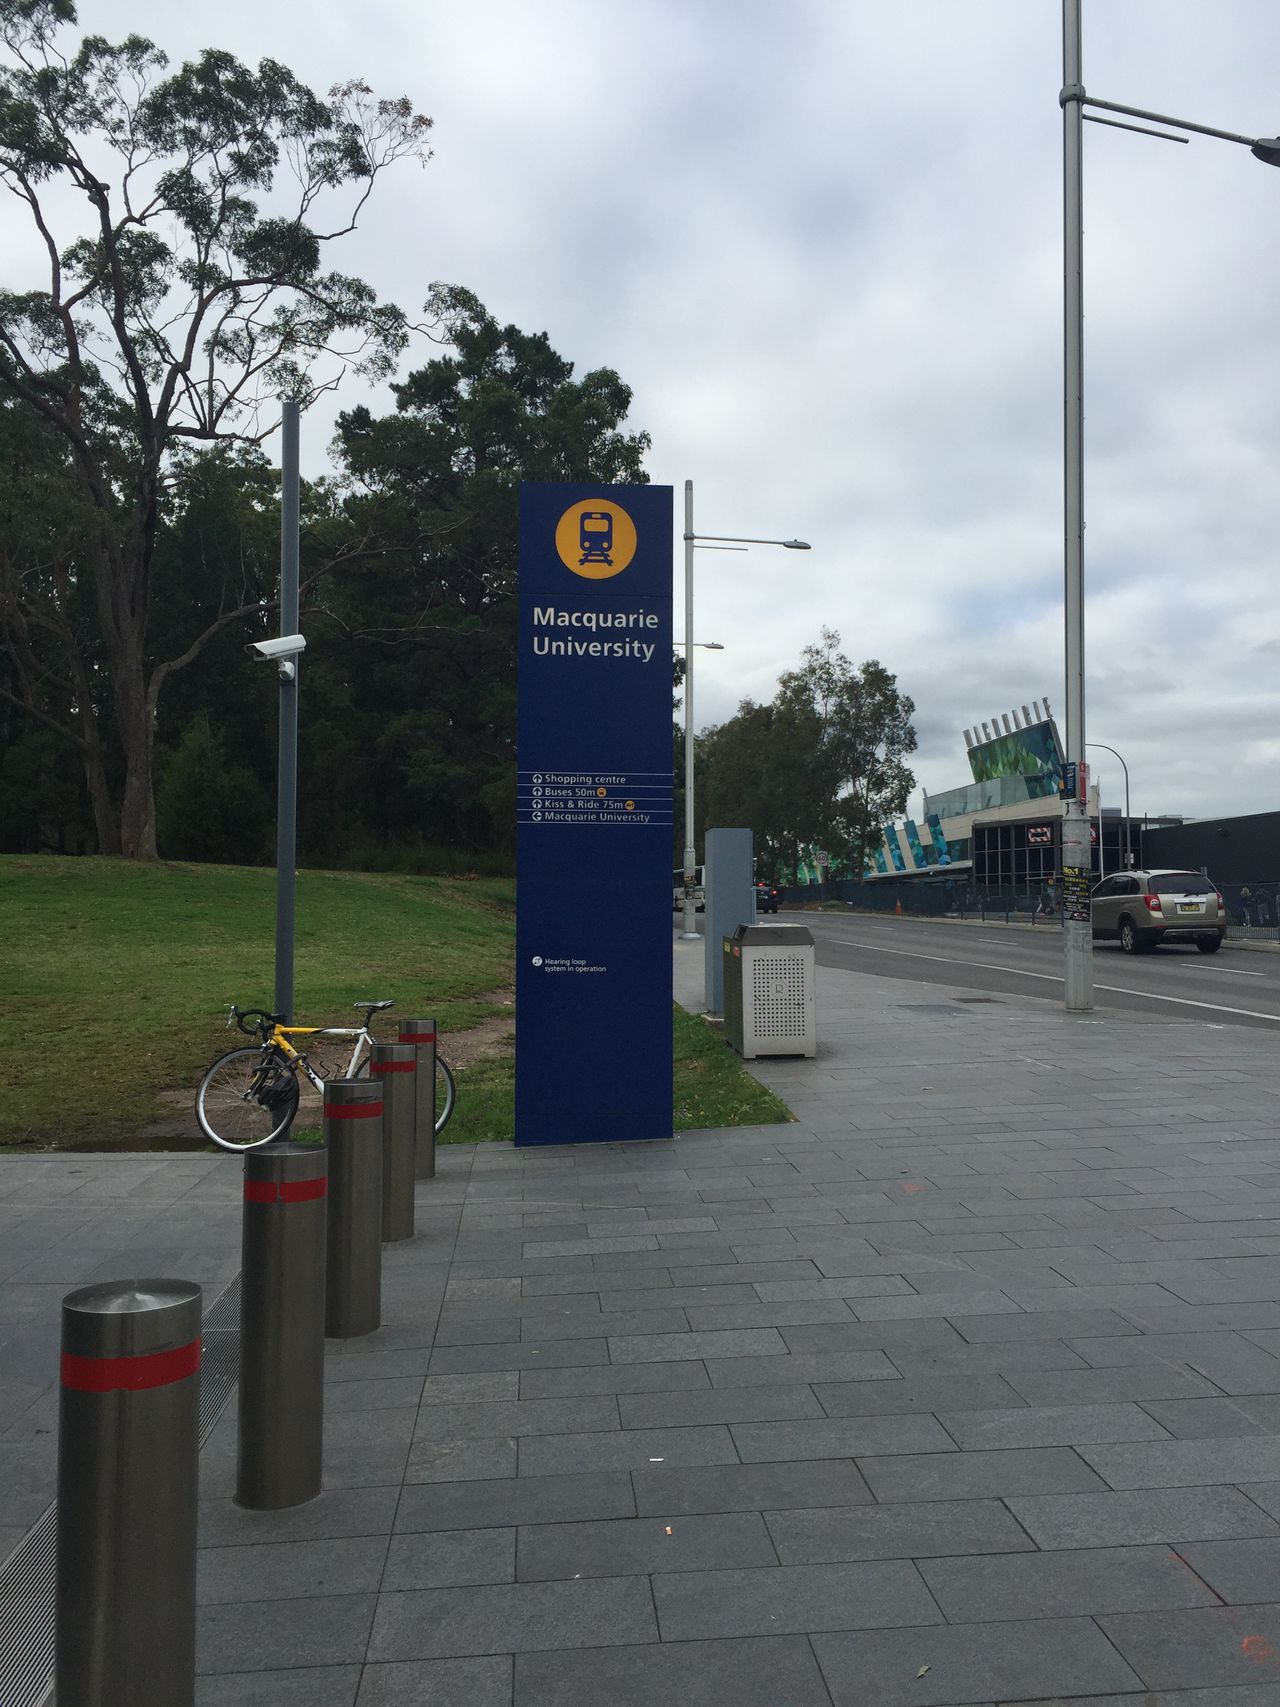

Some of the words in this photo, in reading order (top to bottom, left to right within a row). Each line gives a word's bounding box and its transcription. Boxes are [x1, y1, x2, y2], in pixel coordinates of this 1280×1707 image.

[533, 607, 659, 632] Macquarie
[533, 636, 655, 662] University
[544, 774, 592, 784] Shopping
[595, 775, 626, 784] centre
[544, 787, 573, 796] Buses
[575, 787, 596, 797] 50m
[544, 800, 565, 809] Kiss
[567, 800, 575, 809] &
[577, 800, 600, 809] Ride
[603, 800, 624, 809] 75m
[544, 812, 597, 822] Macquarie
[599, 812, 650, 823] University
[544, 958, 571, 966] Hearing
[571, 958, 587, 966] loop
